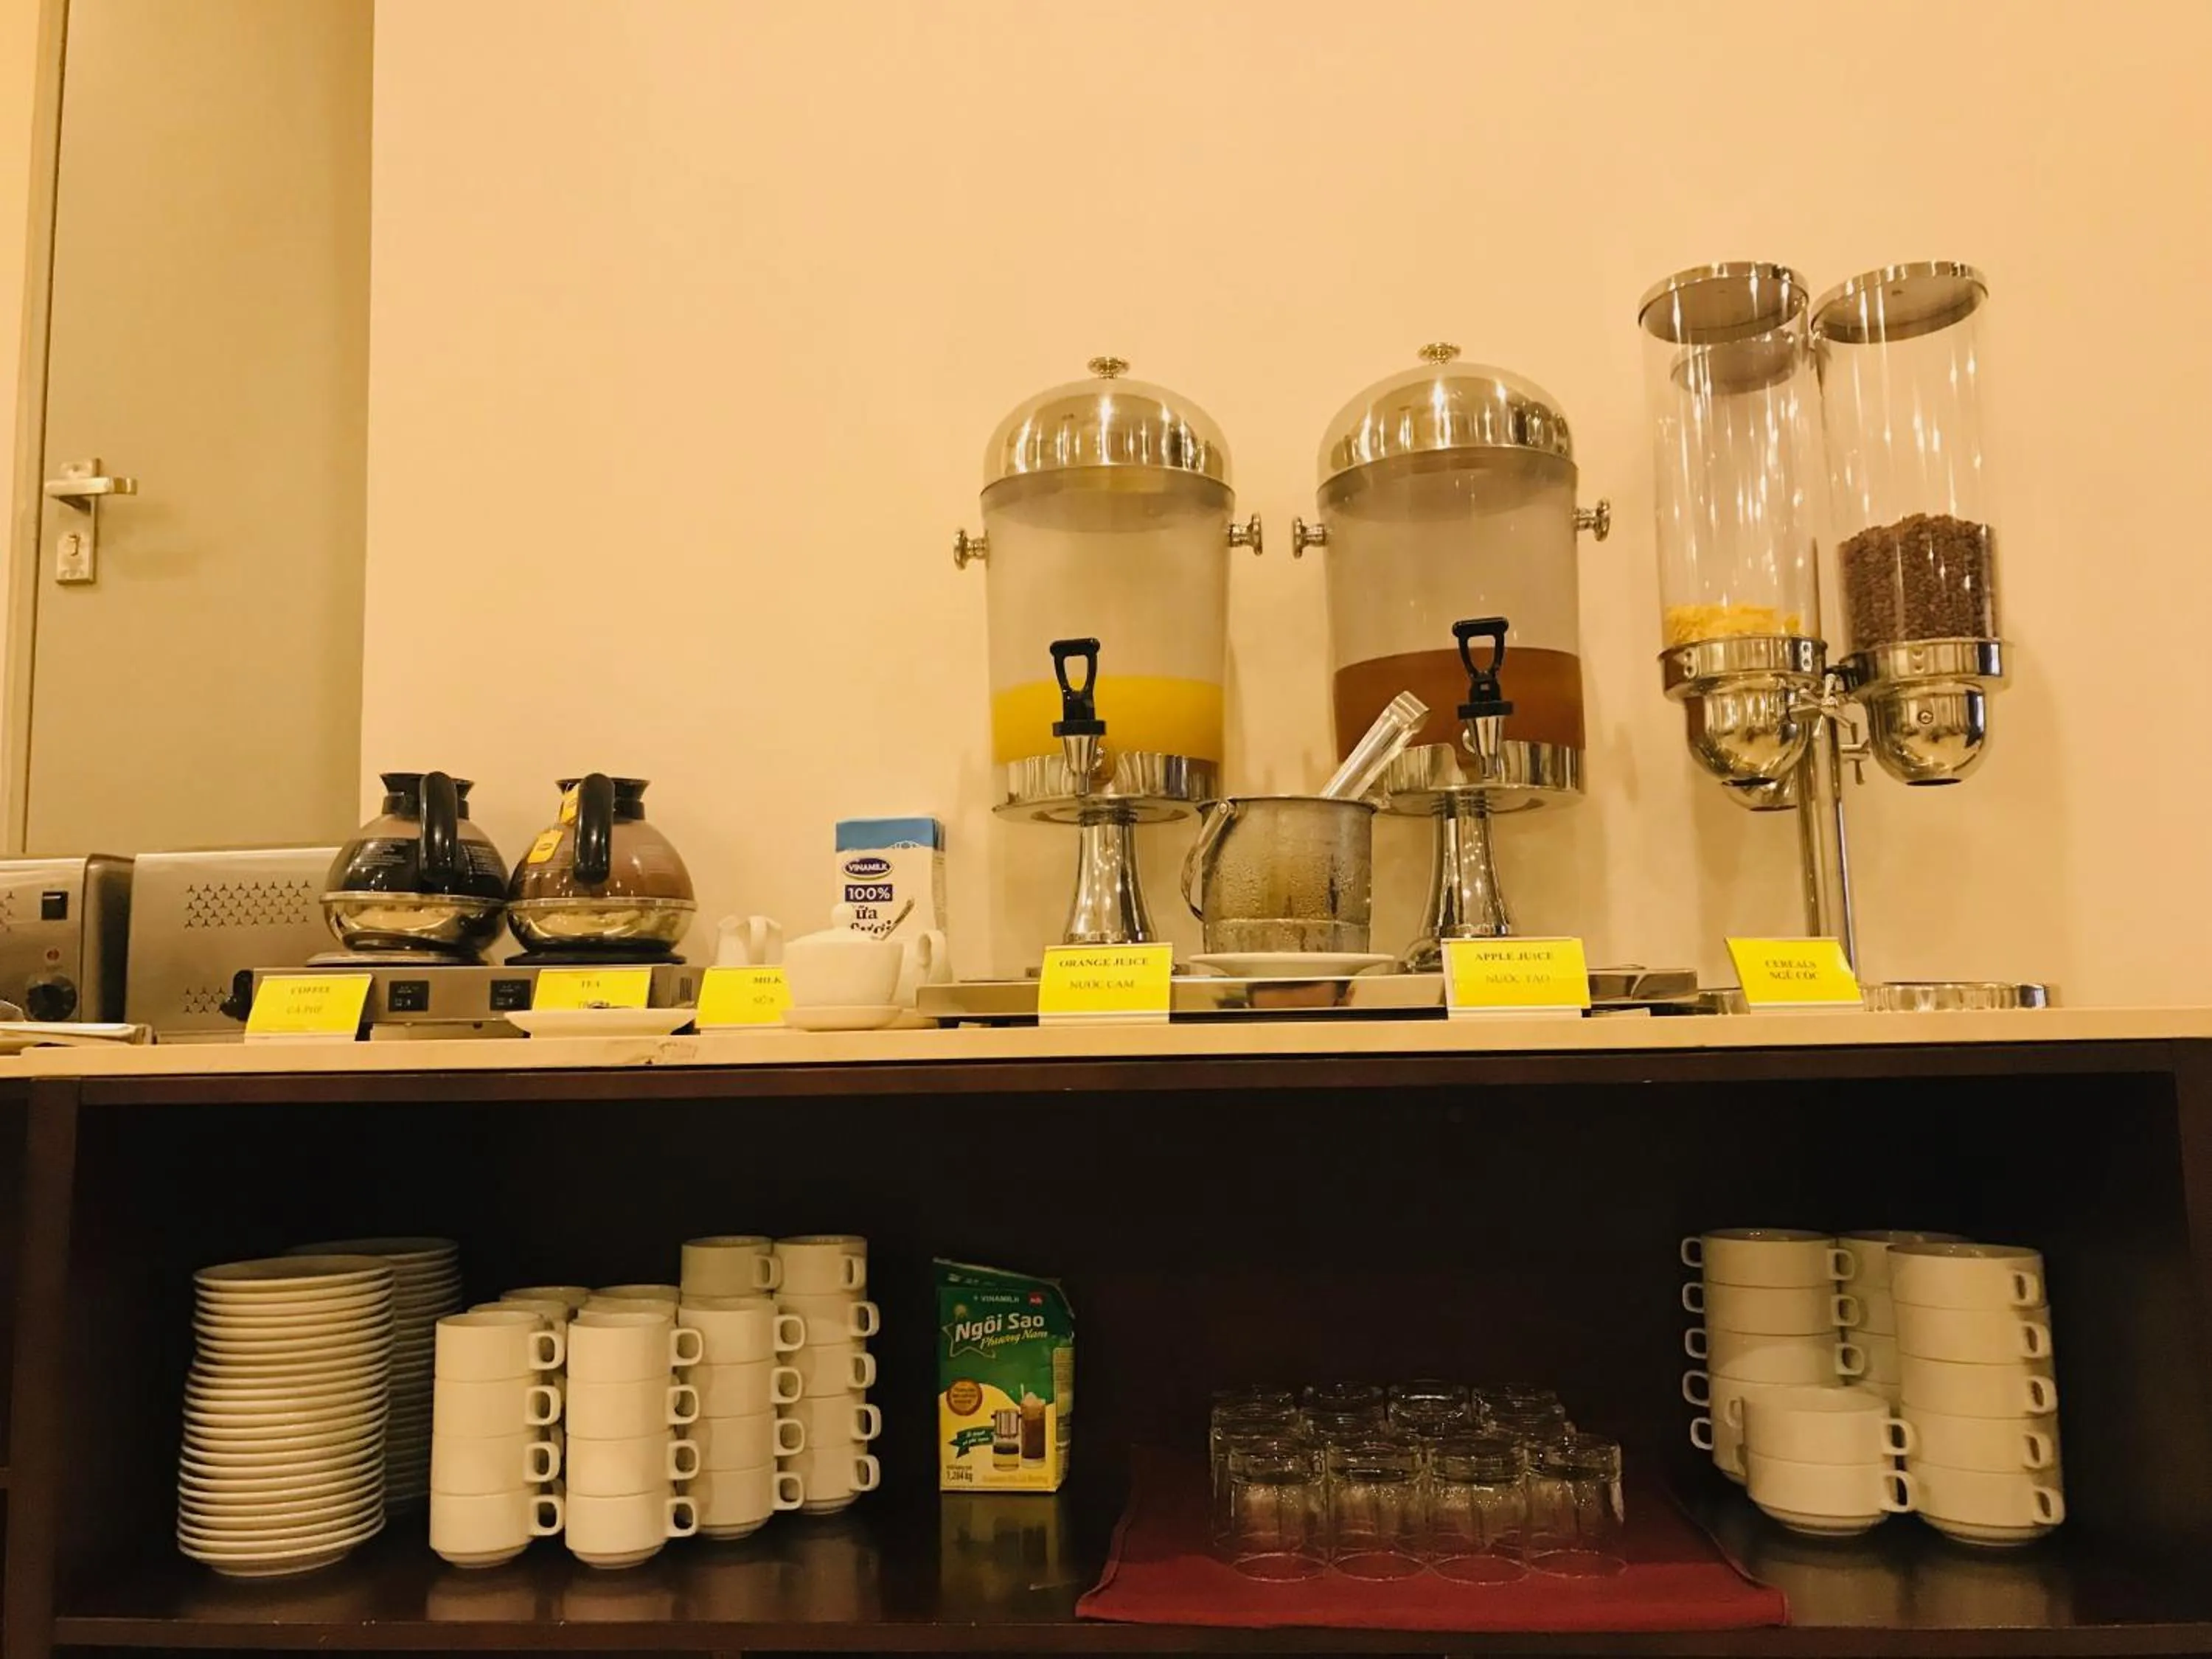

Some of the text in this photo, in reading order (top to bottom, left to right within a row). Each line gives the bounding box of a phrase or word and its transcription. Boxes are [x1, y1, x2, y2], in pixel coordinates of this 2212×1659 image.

[849, 863, 888, 872] VINAMILK
[848, 887, 890, 900] 100%
[853, 905, 878, 919] ữa
[1475, 951, 1554, 961] APPLE JUICE
[1059, 957, 1150, 967] ORANGE JUICE
[753, 975, 782, 984] MILK
[1107, 978, 1135, 990] CAM
[291, 985, 330, 995] COFFEE
[955, 1312, 1045, 1343] Ngôi Sao
[1021, 1329, 1048, 1340] Nam
